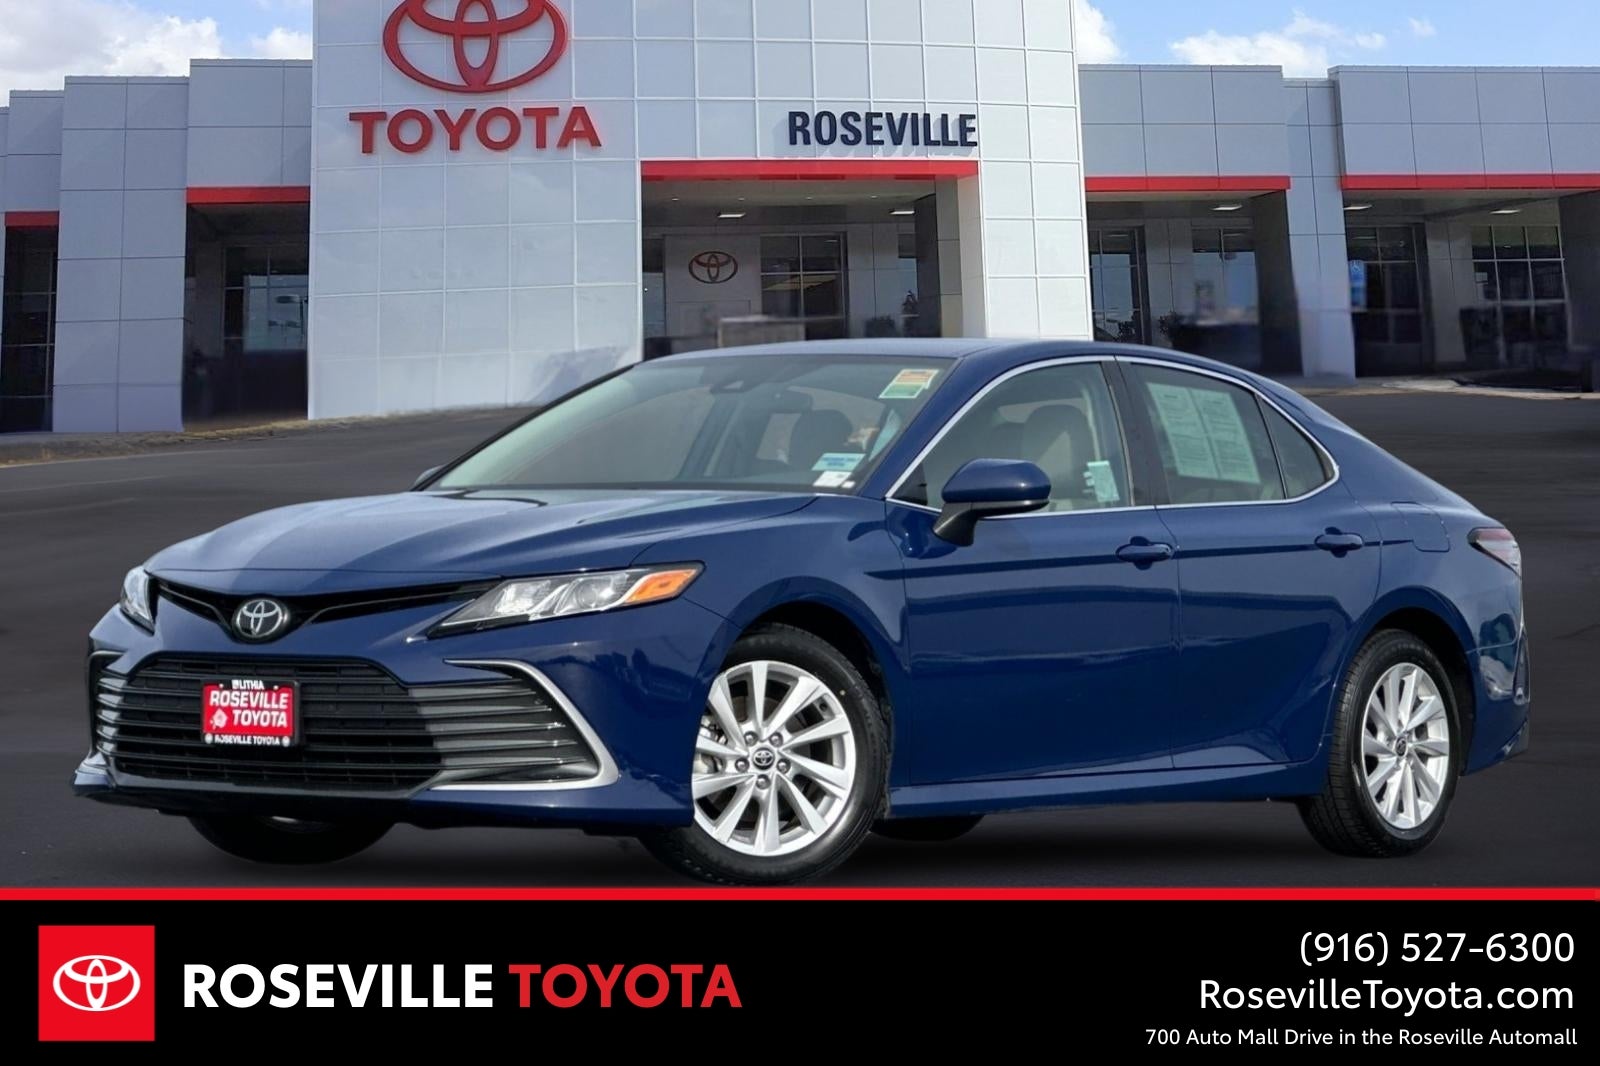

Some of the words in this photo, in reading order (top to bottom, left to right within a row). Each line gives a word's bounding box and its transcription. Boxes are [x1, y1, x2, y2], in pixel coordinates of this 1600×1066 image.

[349, 106, 602, 154] TOYOTA
[788, 110, 978, 147] ROSEVILLE
[239, 680, 265, 690] LITHIA
[209, 690, 289, 709] ROSEVILLE
[232, 709, 287, 728] TOYOTA
